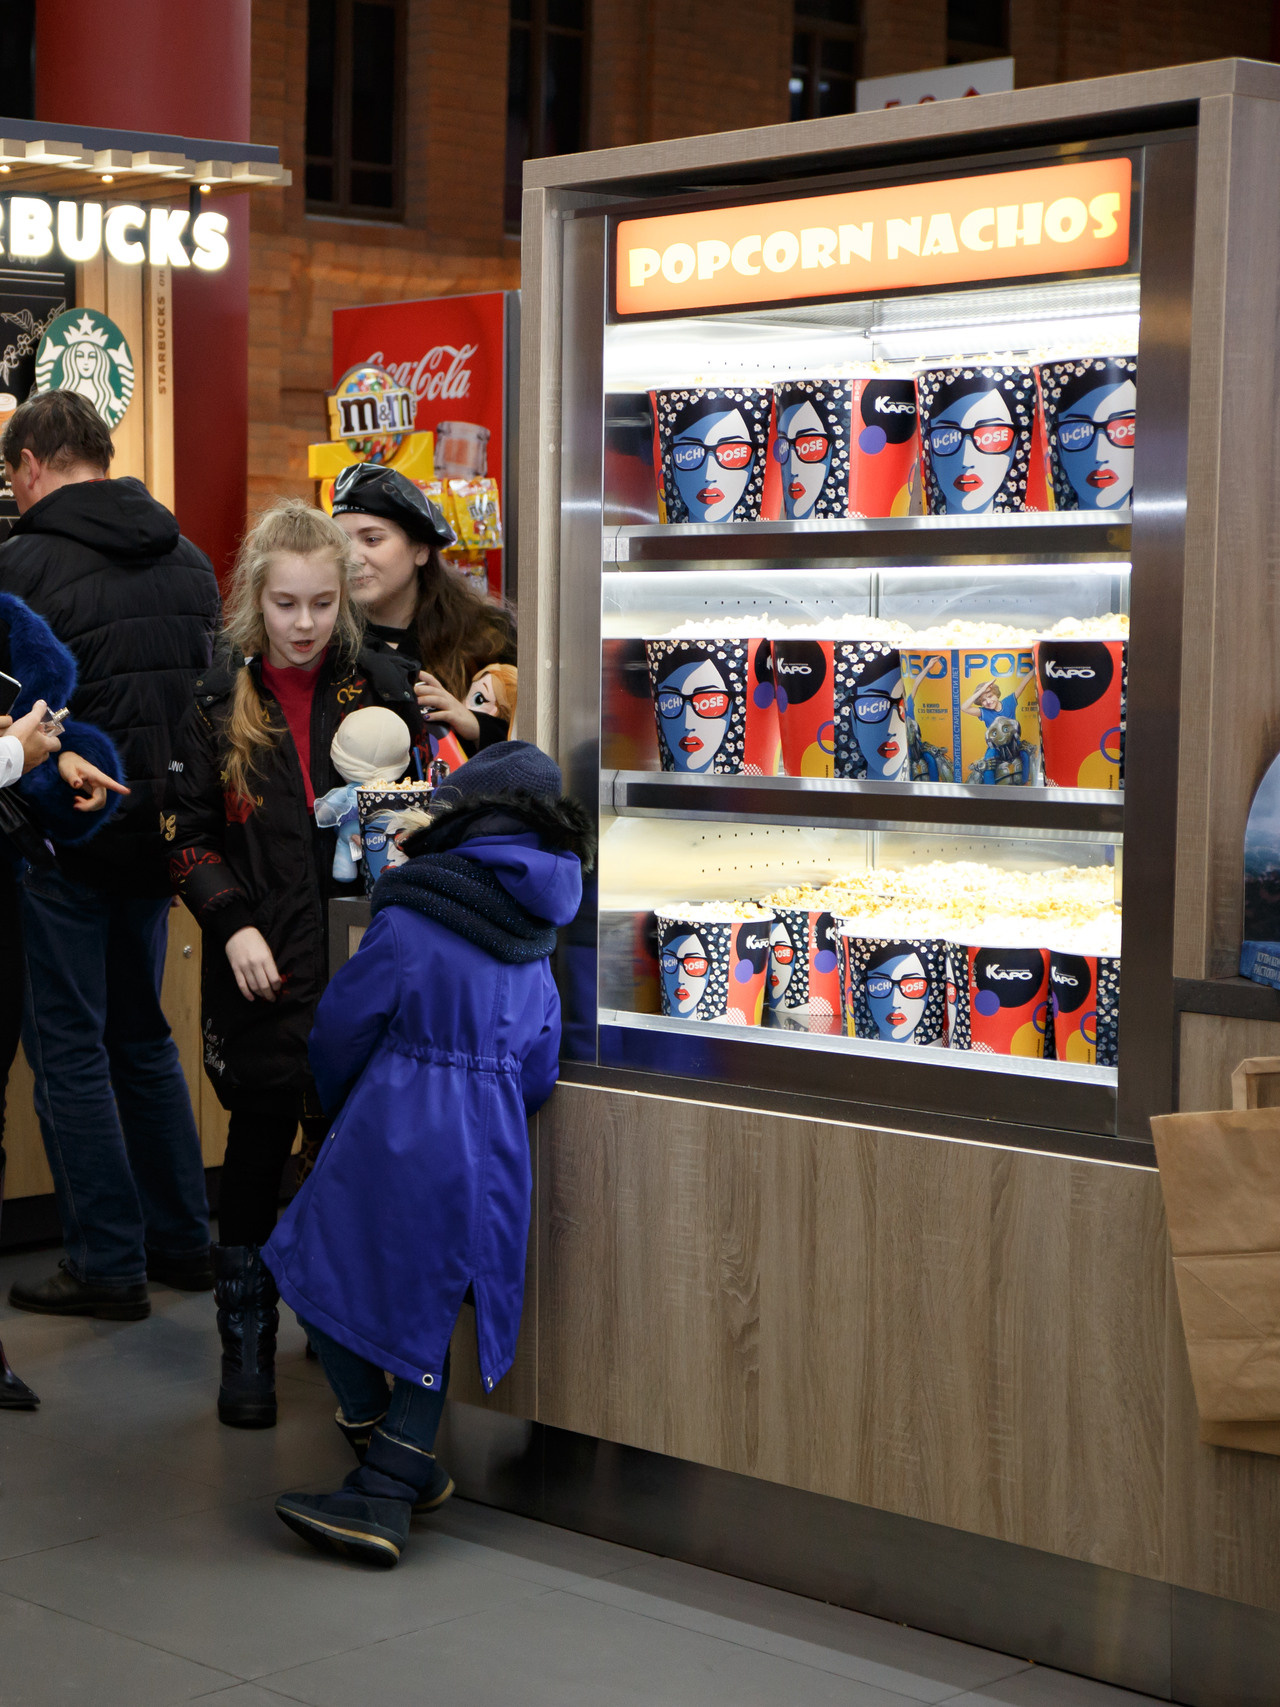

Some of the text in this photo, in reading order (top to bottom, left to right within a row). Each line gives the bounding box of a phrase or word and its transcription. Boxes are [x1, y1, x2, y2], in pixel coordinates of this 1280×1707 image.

[628, 192, 1120, 287] POPCORN NACHOS
[157, 296, 166, 395] STARBUCKS
[366, 343, 479, 403] ca-Cola
